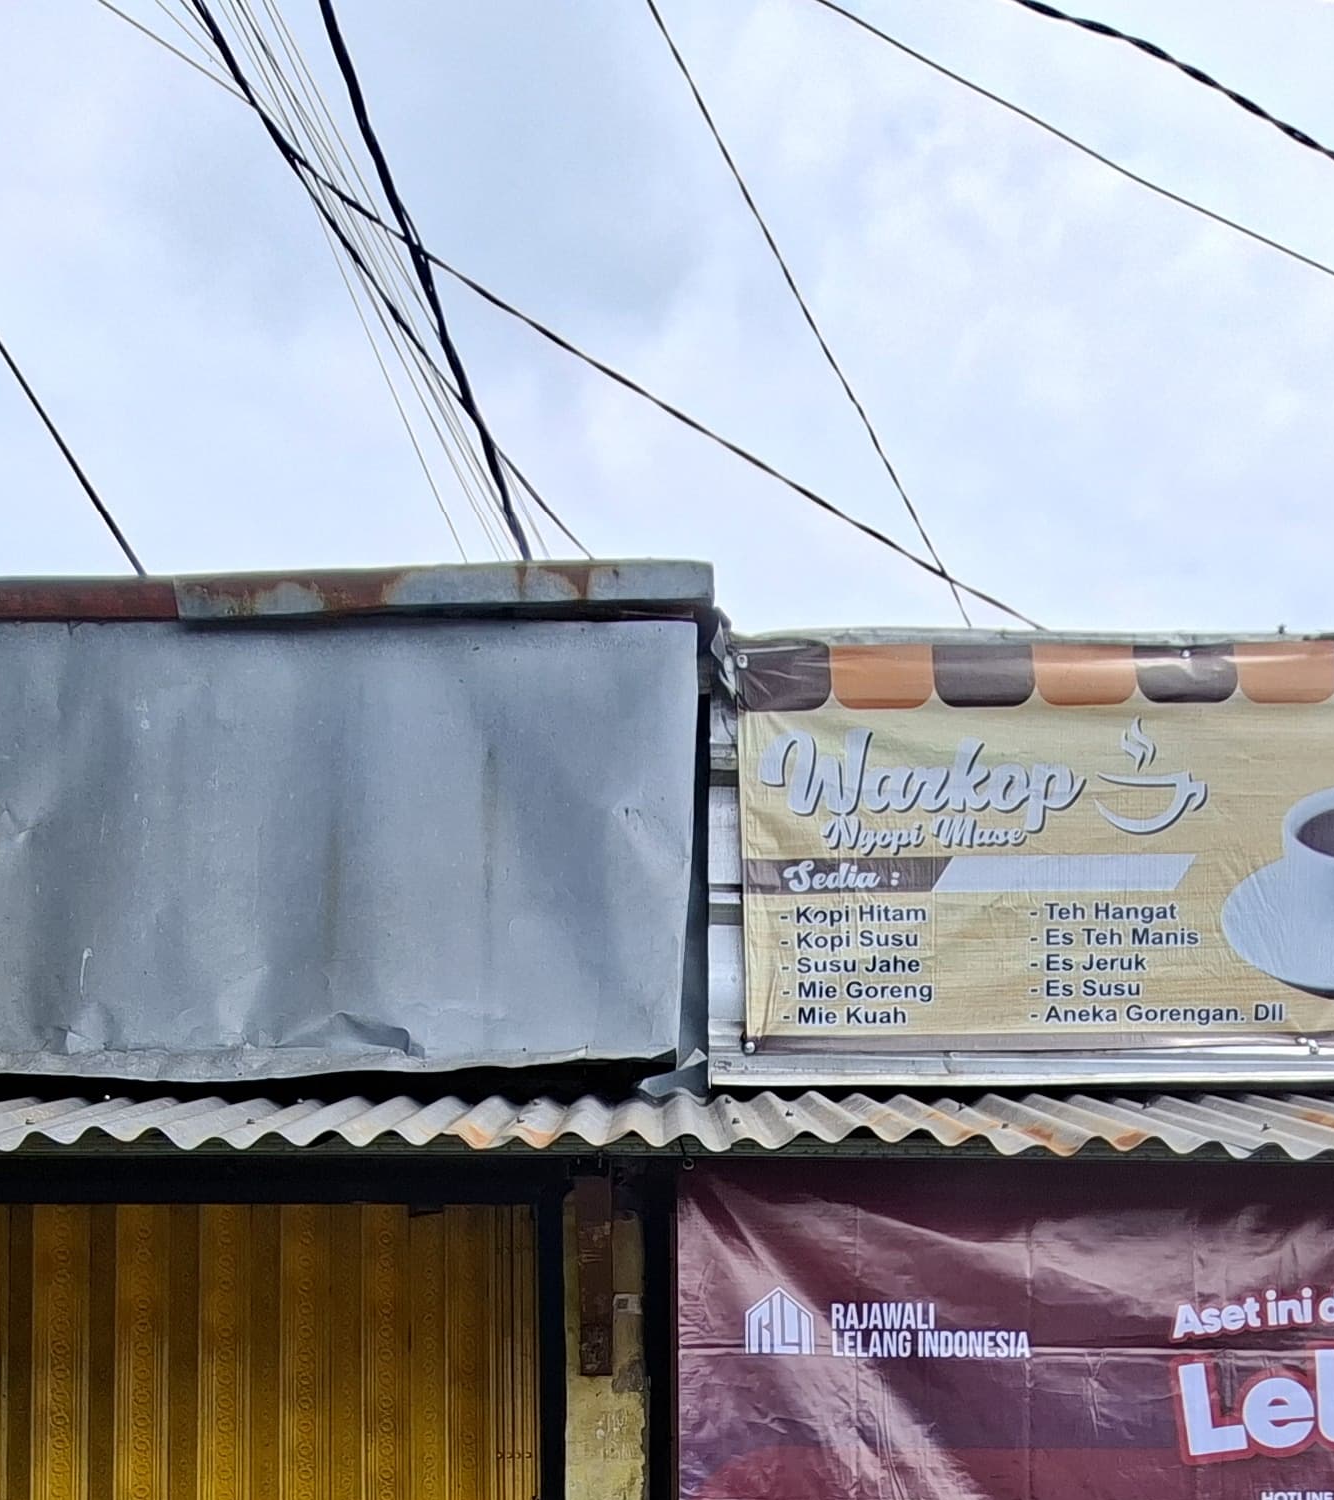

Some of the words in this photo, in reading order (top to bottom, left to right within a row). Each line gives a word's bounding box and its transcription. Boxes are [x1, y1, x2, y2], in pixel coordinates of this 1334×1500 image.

[760, 729, 1086, 832] Warkop
[821, 814, 924, 856] Ngopi
[783, 860, 881, 893] Sedia
[796, 905, 850, 927] Kopi
[859, 905, 927, 922] Hitam
[1045, 903, 1085, 920] Teh
[1094, 902, 1177, 924] Hangat
[796, 931, 851, 952] Kopi
[859, 930, 919, 948] Susu
[1046, 929, 1074, 946] Es
[1083, 929, 1122, 946] Teh
[1132, 928, 1199, 945] Manis
[797, 957, 857, 974] Susu
[865, 955, 921, 973] Jahe
[1046, 954, 1074, 971] Es
[1083, 954, 1147, 971] Jeruk
[798, 981, 838, 999] Mie
[846, 981, 933, 1002] Goreng
[1046, 980, 1074, 997] Es
[1083, 980, 1141, 997] Susu
[798, 1007, 838, 1025] Mie
[846, 1007, 907, 1025] Kuah
[1045, 1006, 1117, 1022] Aneka
[1126, 1004, 1245, 1025] Gorengan.
[1254, 1004, 1283, 1021] Dll
[831, 1303, 935, 1329] RAJAWALI
[1173, 1297, 1261, 1339] Aset
[1266, 1288, 1312, 1326] ini
[831, 1330, 911, 1358] LELANG
[918, 1331, 1031, 1358] INDONESIA
